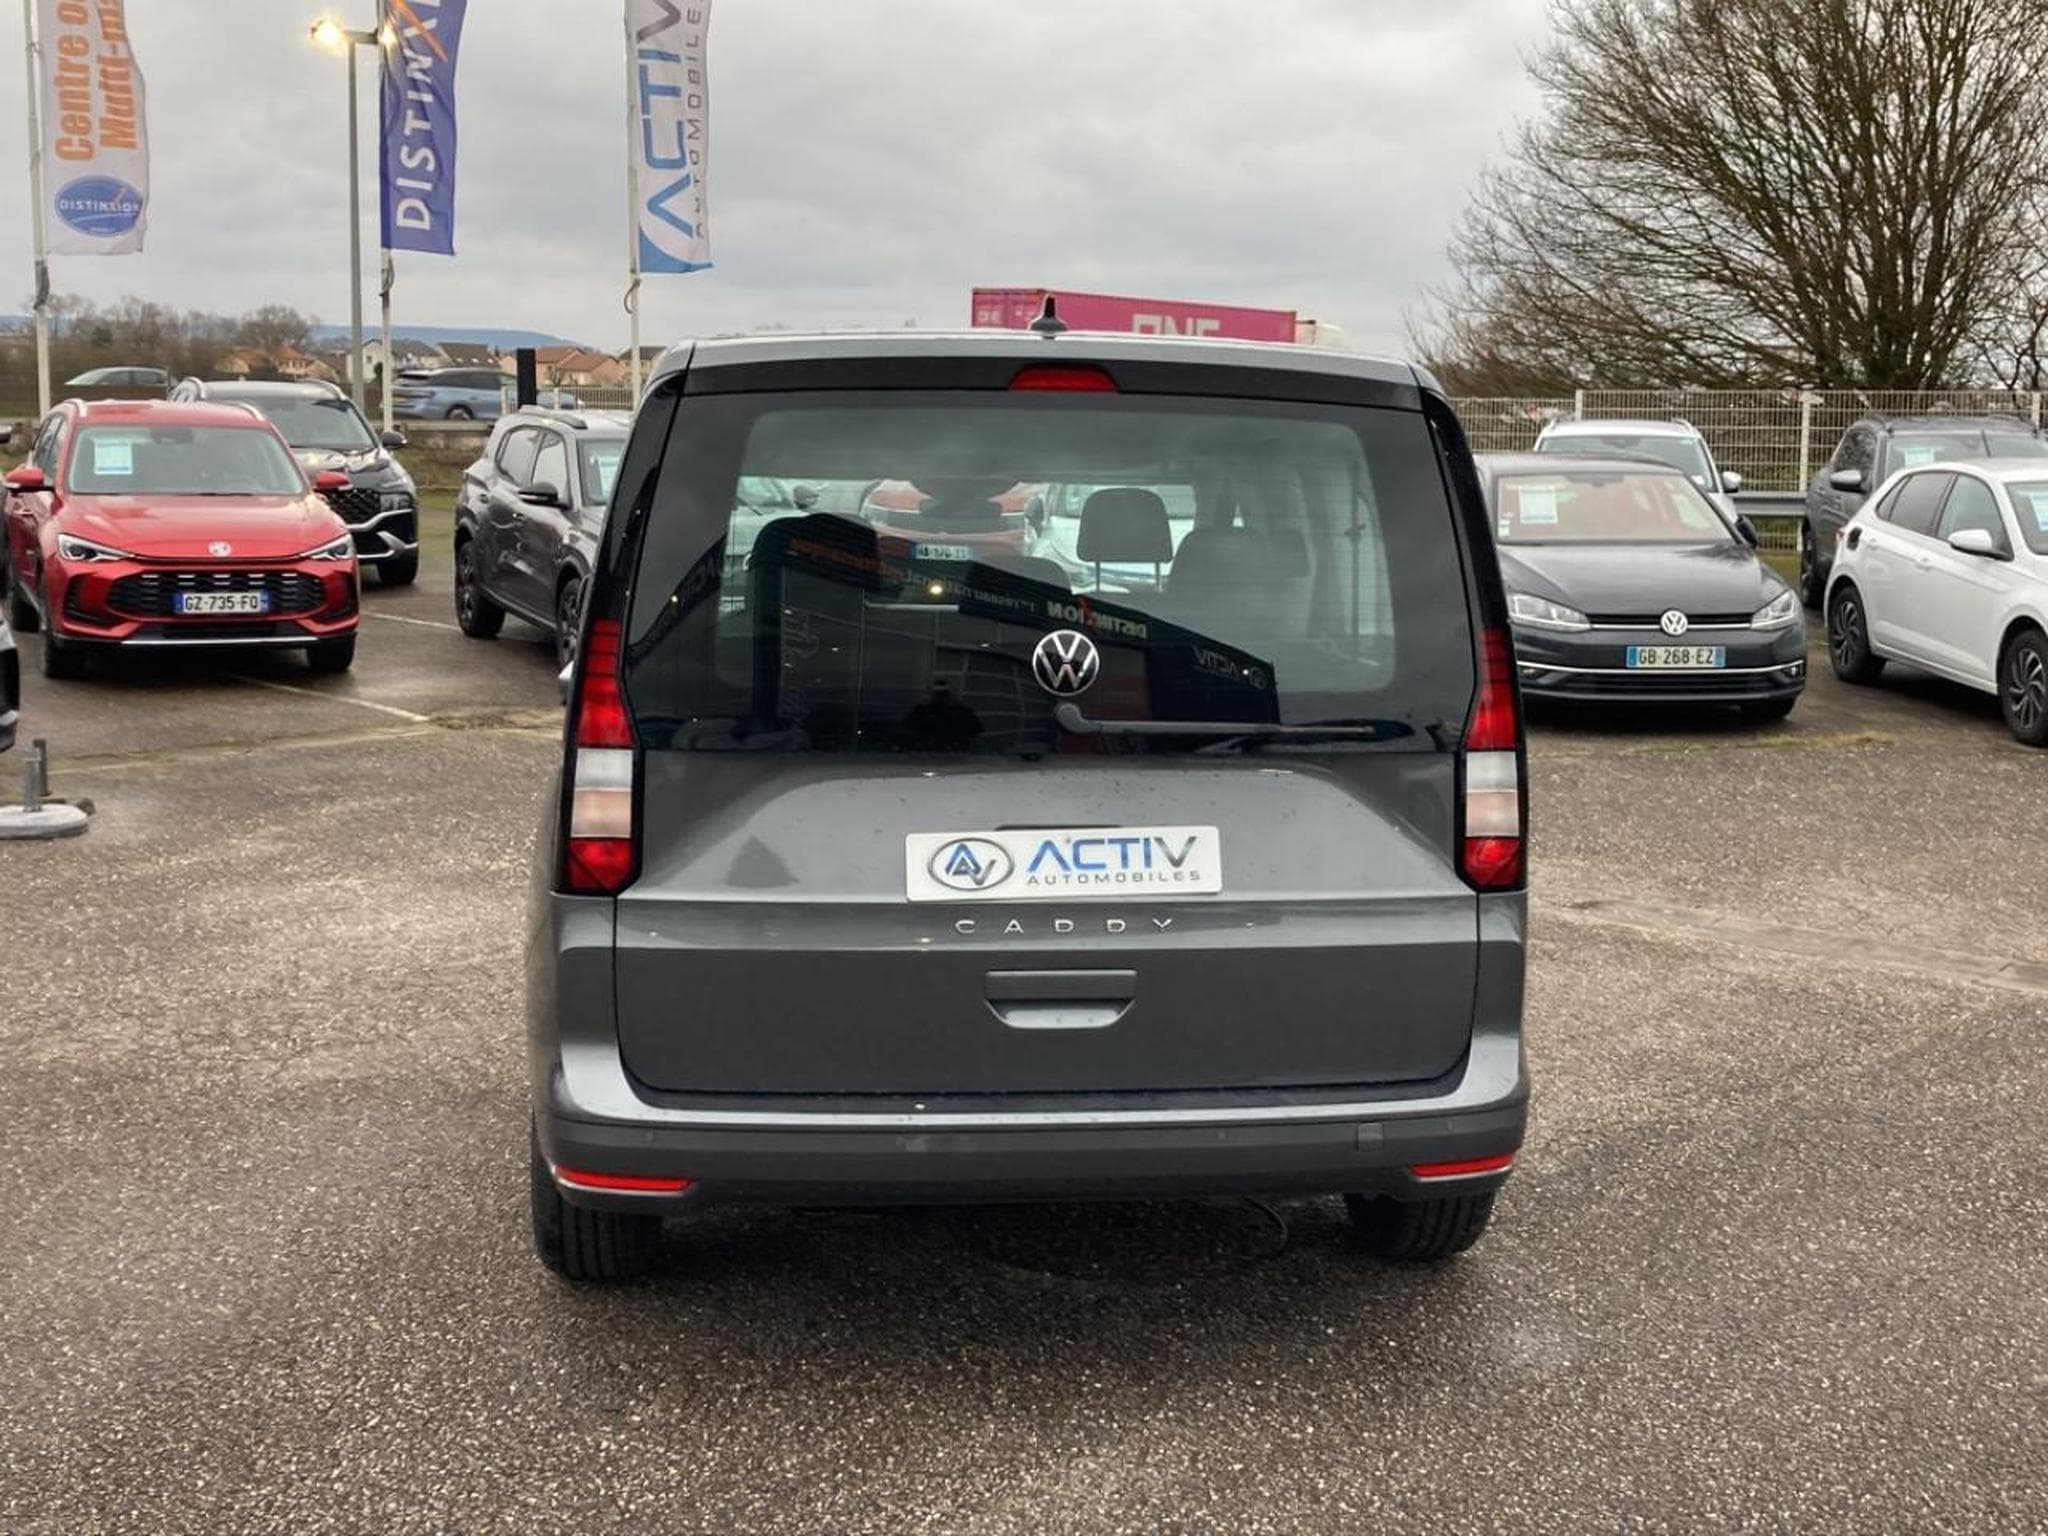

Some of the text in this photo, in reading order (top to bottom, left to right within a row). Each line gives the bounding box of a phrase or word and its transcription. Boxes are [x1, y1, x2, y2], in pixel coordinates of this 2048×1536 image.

[53, 35, 94, 160] Centre
[635, 0, 694, 239] ACTIV
[1028, 836, 1198, 873] ACTIV
[1027, 869, 1201, 885] AUTOMOBILES
[954, 917, 1173, 935] CADDY
